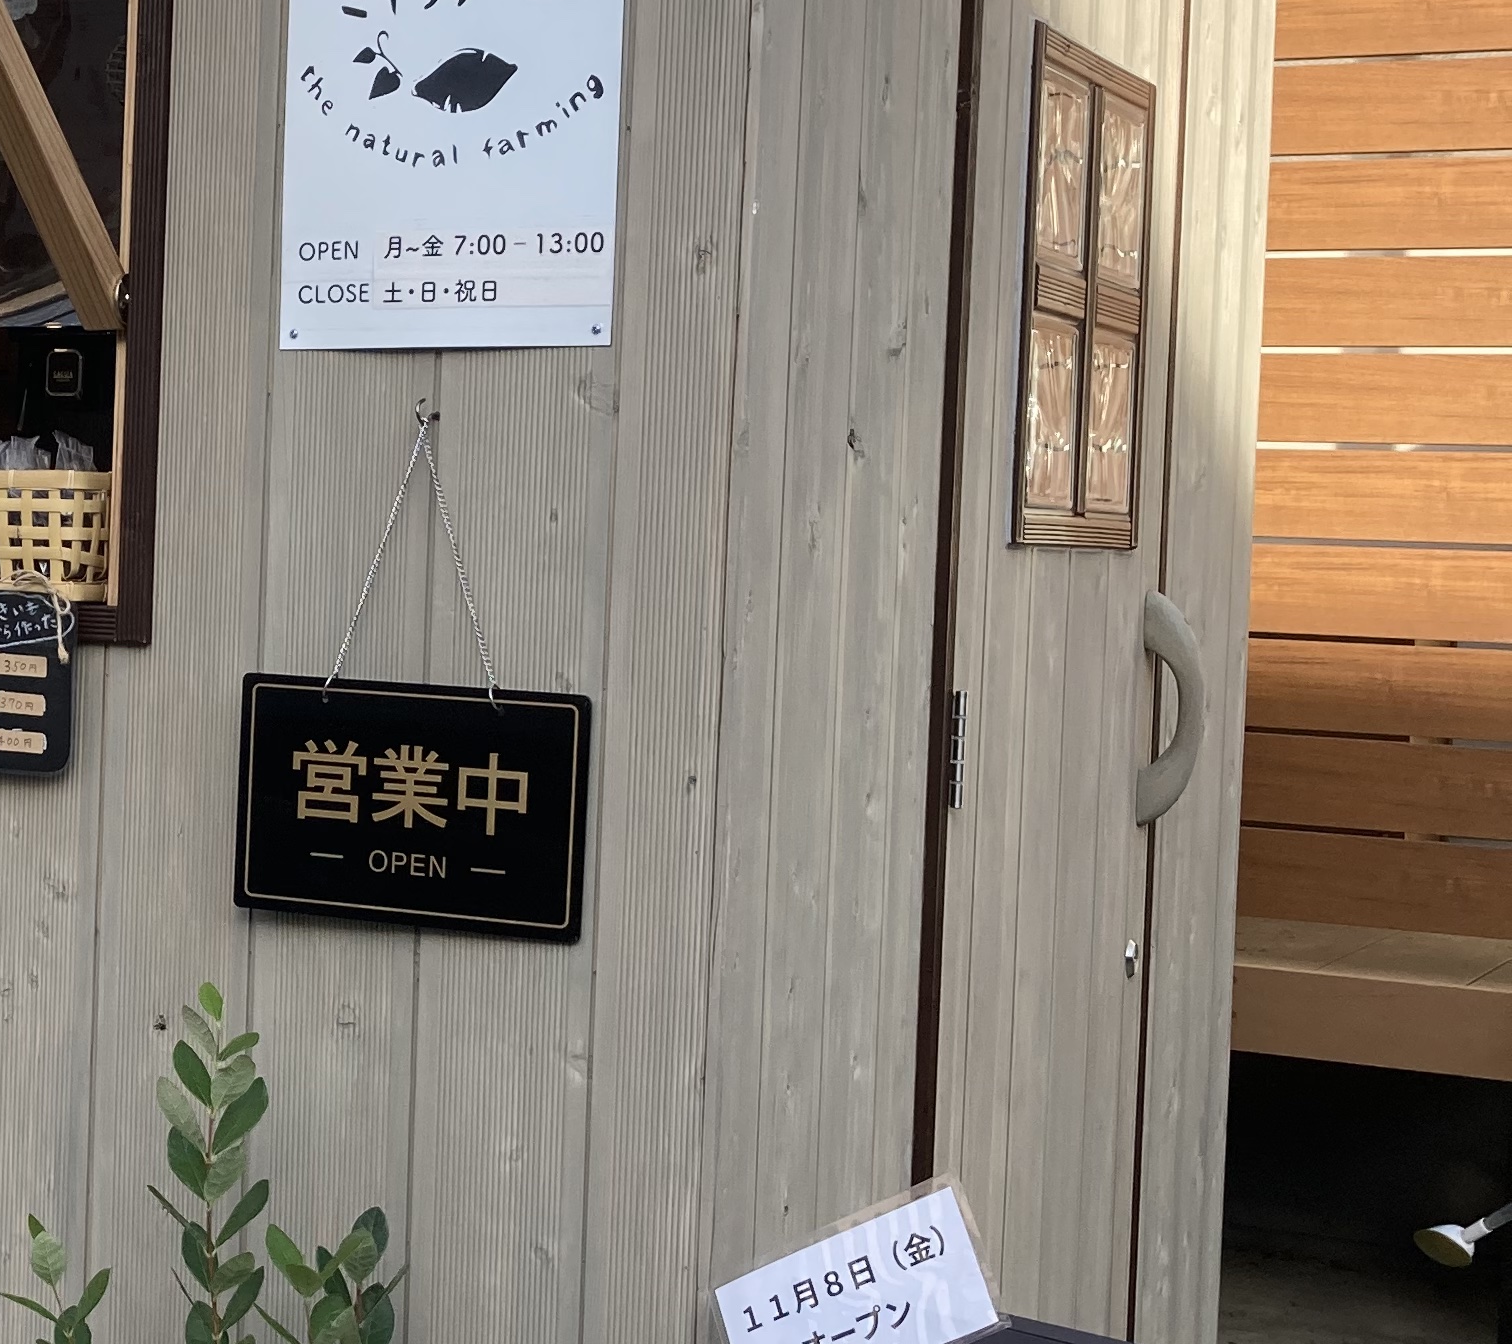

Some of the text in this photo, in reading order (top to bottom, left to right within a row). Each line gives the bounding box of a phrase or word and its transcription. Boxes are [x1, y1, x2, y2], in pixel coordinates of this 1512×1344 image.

[345, 123, 458, 168] natural
[482, 74, 605, 158] farming
[299, 240, 359, 262] OPEN
[454, 234, 507, 256] 7:00
[536, 231, 605, 255] 13:00
[298, 283, 370, 305] CLOSE
[4, 659, 38, 673] 350円
[0, 697, 34, 711] 370円
[293, 740, 529, 836] 営業中
[368, 850, 447, 879] OPEN
